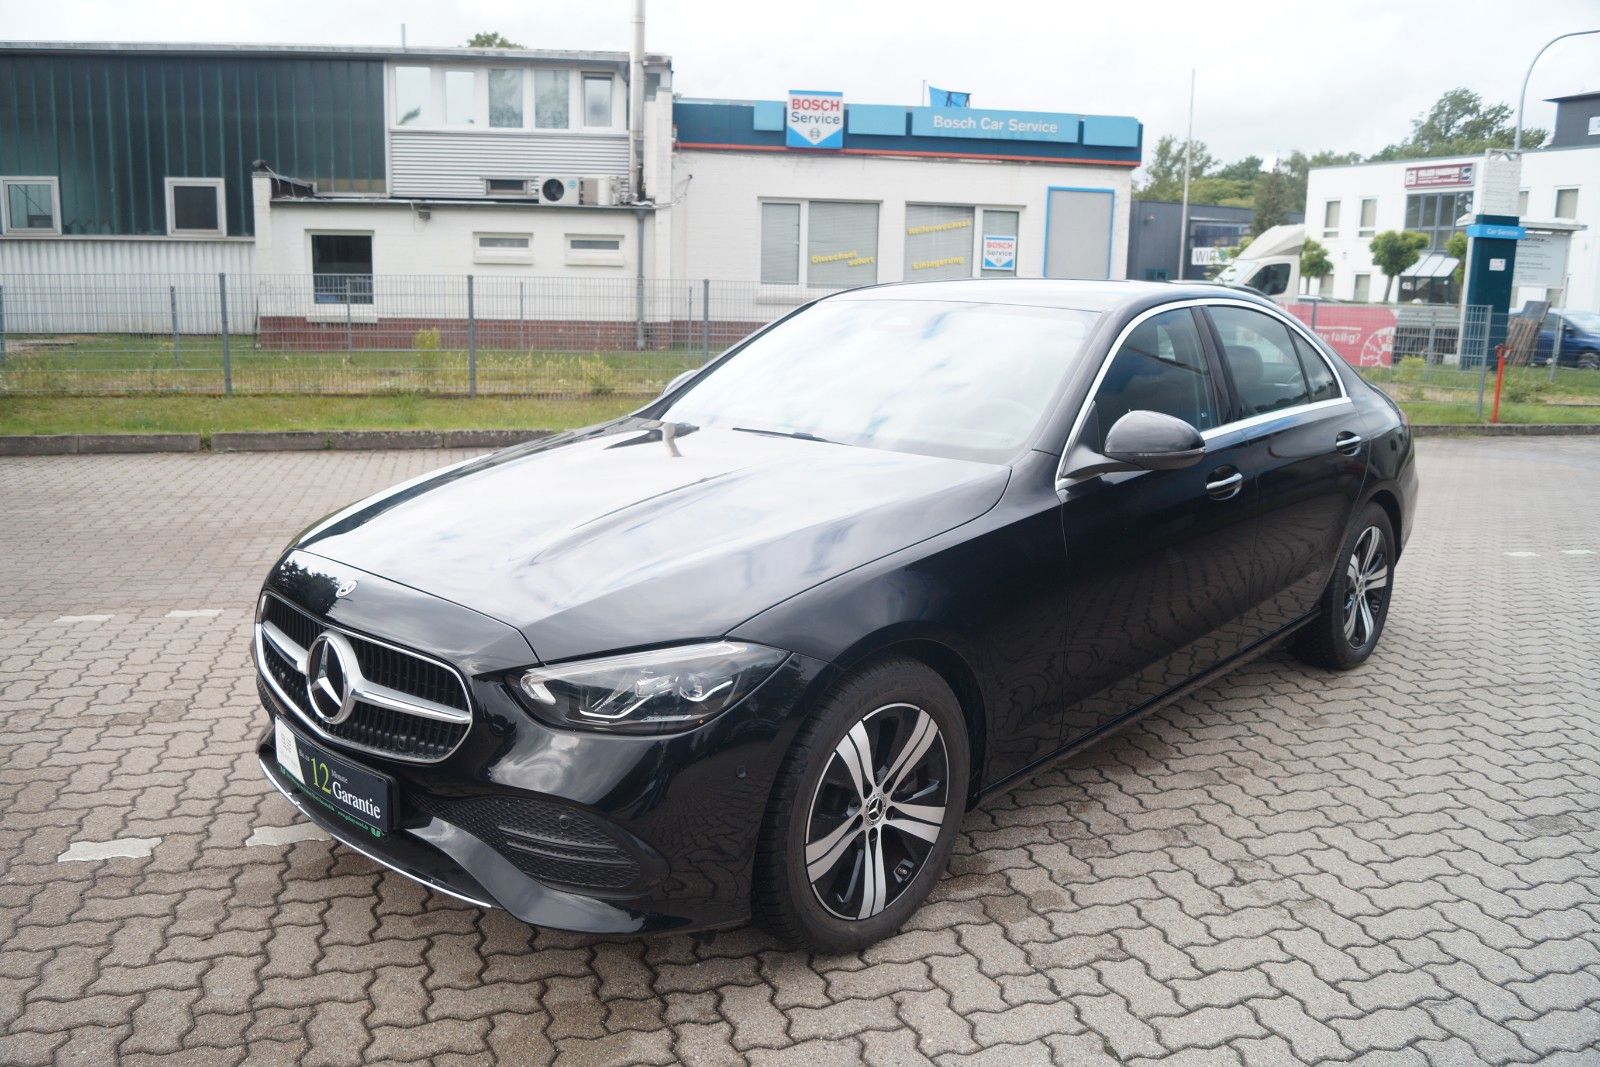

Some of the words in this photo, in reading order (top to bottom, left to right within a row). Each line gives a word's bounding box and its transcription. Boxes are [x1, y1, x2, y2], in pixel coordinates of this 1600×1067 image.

[792, 98, 840, 111] BOSCH
[791, 111, 840, 124] Service
[933, 115, 976, 129] Bosch
[980, 117, 1004, 131] Car
[1008, 119, 1058, 133] Service
[985, 241, 1013, 249] BOSCH
[311, 757, 332, 795] 12
[332, 781, 381, 819] Garantie
